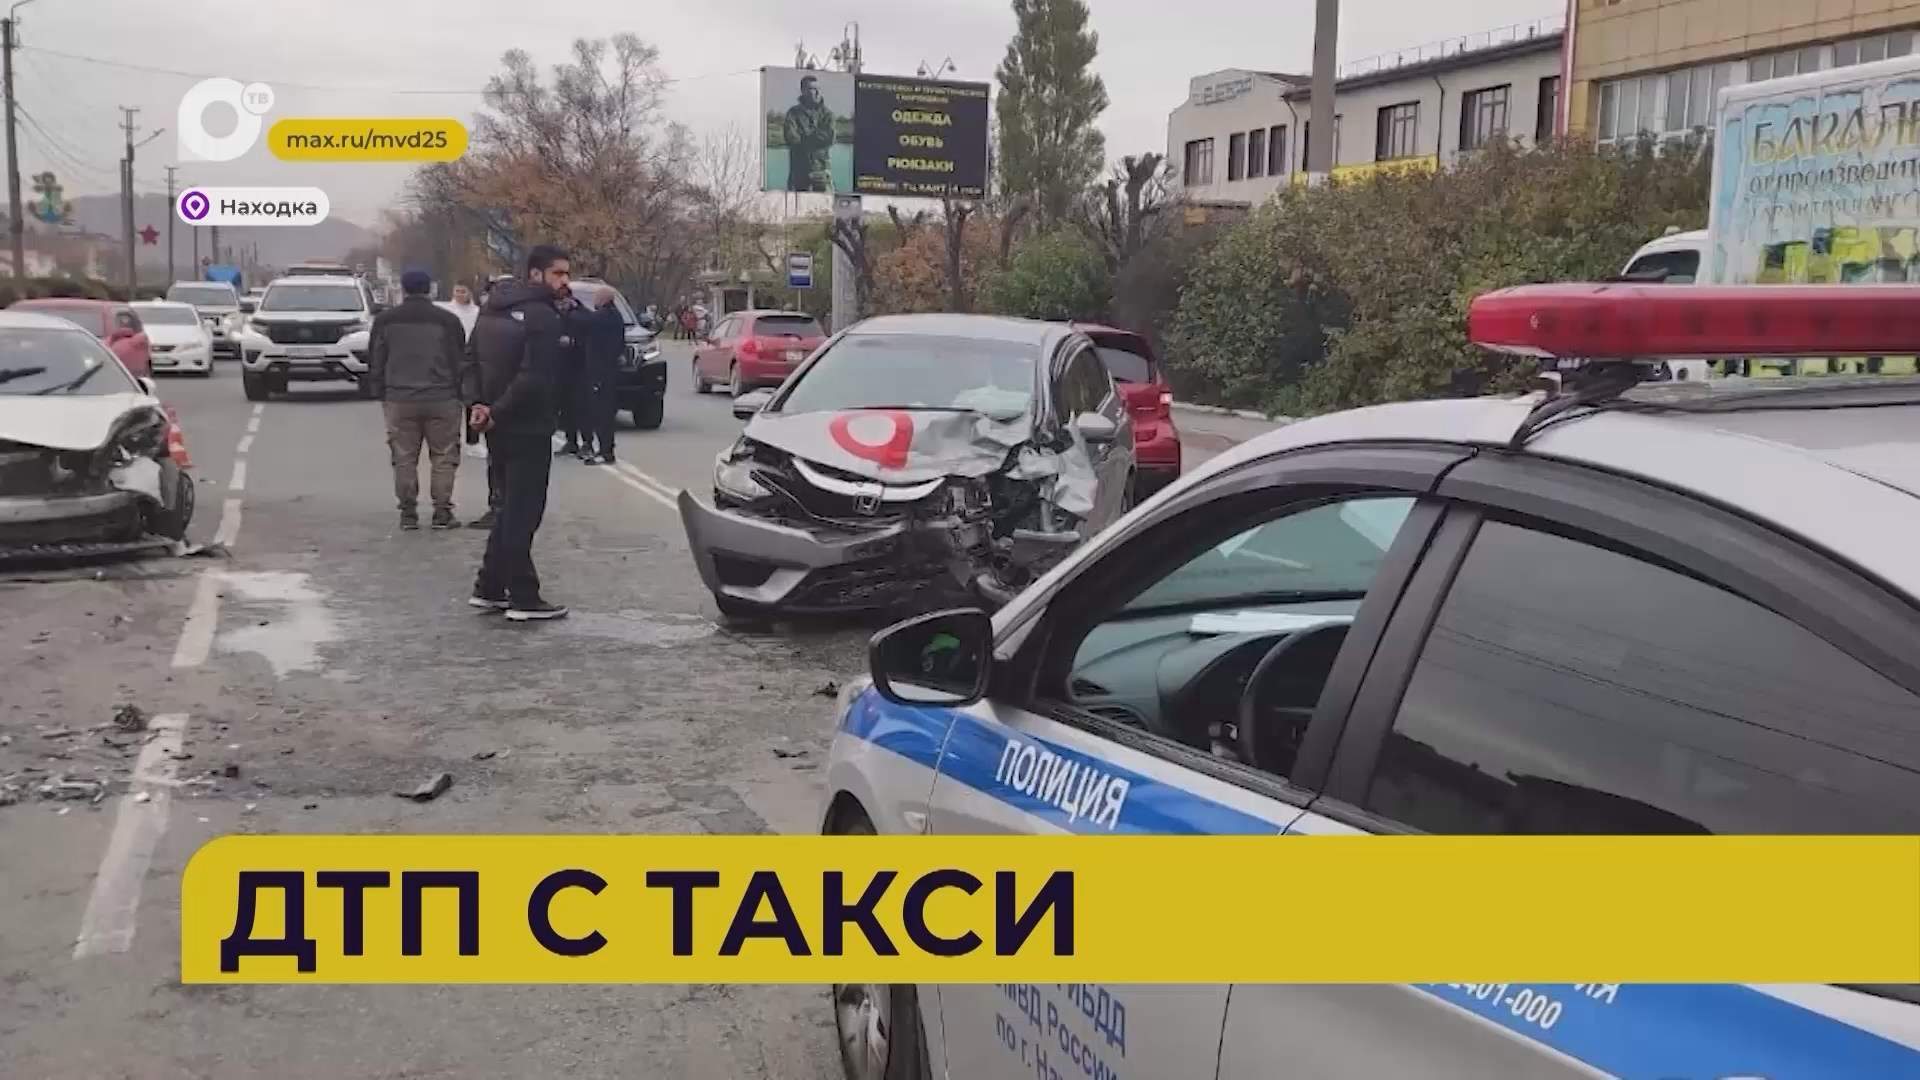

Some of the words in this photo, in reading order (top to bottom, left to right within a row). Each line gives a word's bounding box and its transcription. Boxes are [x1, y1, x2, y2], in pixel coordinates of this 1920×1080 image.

[891, 109, 952, 126] ОДЕЖДА
[899, 135, 944, 148] ОБУВЬ
[887, 157, 954, 172] РЮКЗАКИ
[996, 739, 1130, 831] ПОЛИЦИЯ
[1057, 984, 1126, 1059] ИБДД
[995, 1012, 1016, 1051] по
[1021, 1038, 1032, 1068] г.
